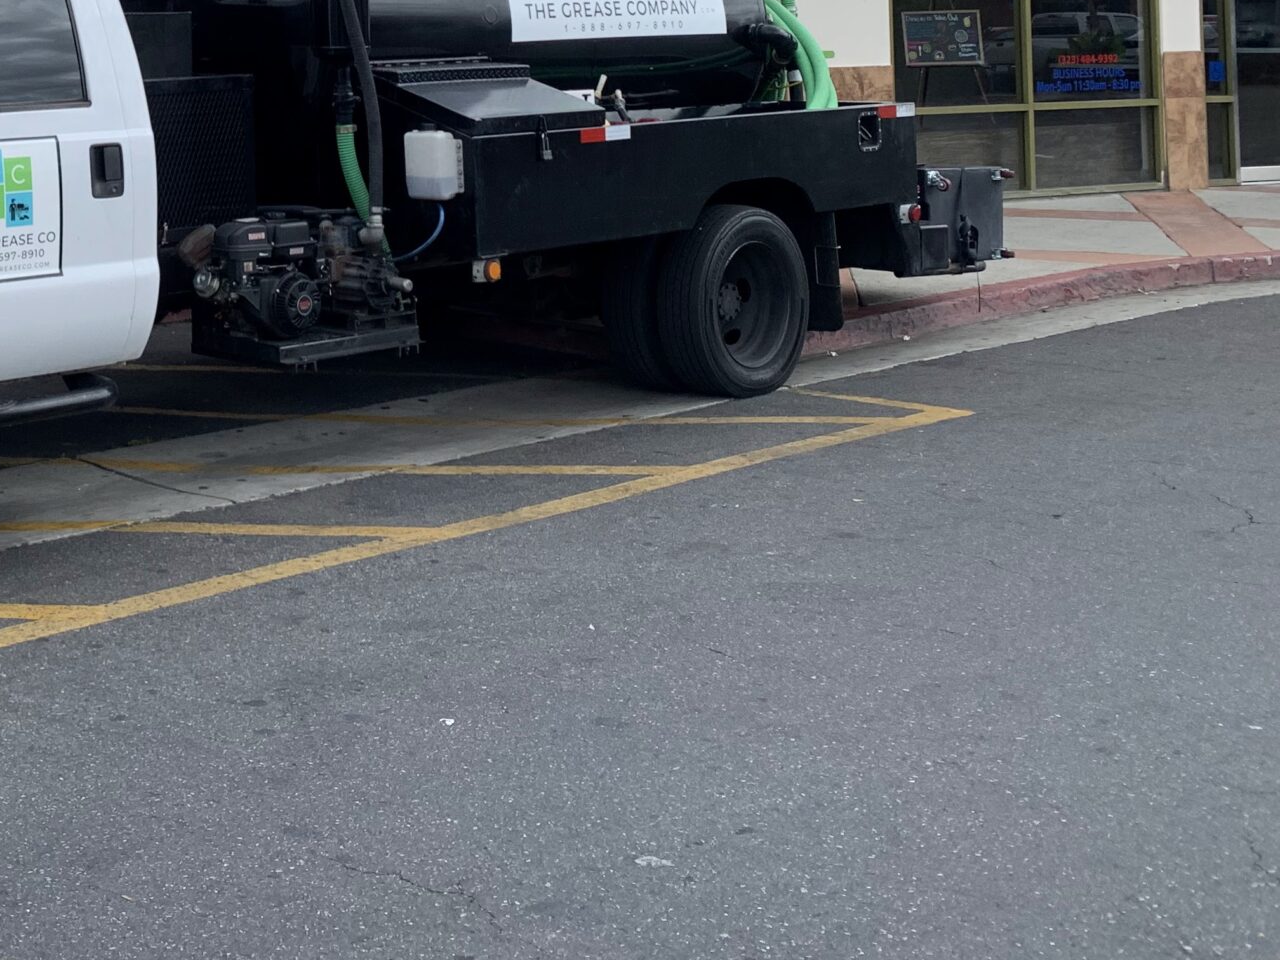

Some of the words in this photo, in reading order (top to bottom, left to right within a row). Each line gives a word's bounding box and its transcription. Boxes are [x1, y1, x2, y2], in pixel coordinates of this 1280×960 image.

[525, 2, 557, 20] THE
[561, 0, 623, 19] GREASE
[626, 0, 698, 16] COMPANY
[564, 20, 684, 32] 1-888-697-8910
[1052, 67, 1094, 79] BUSINESS
[1095, 66, 1126, 78] HOURS
[37, 231, 56, 244] CO
